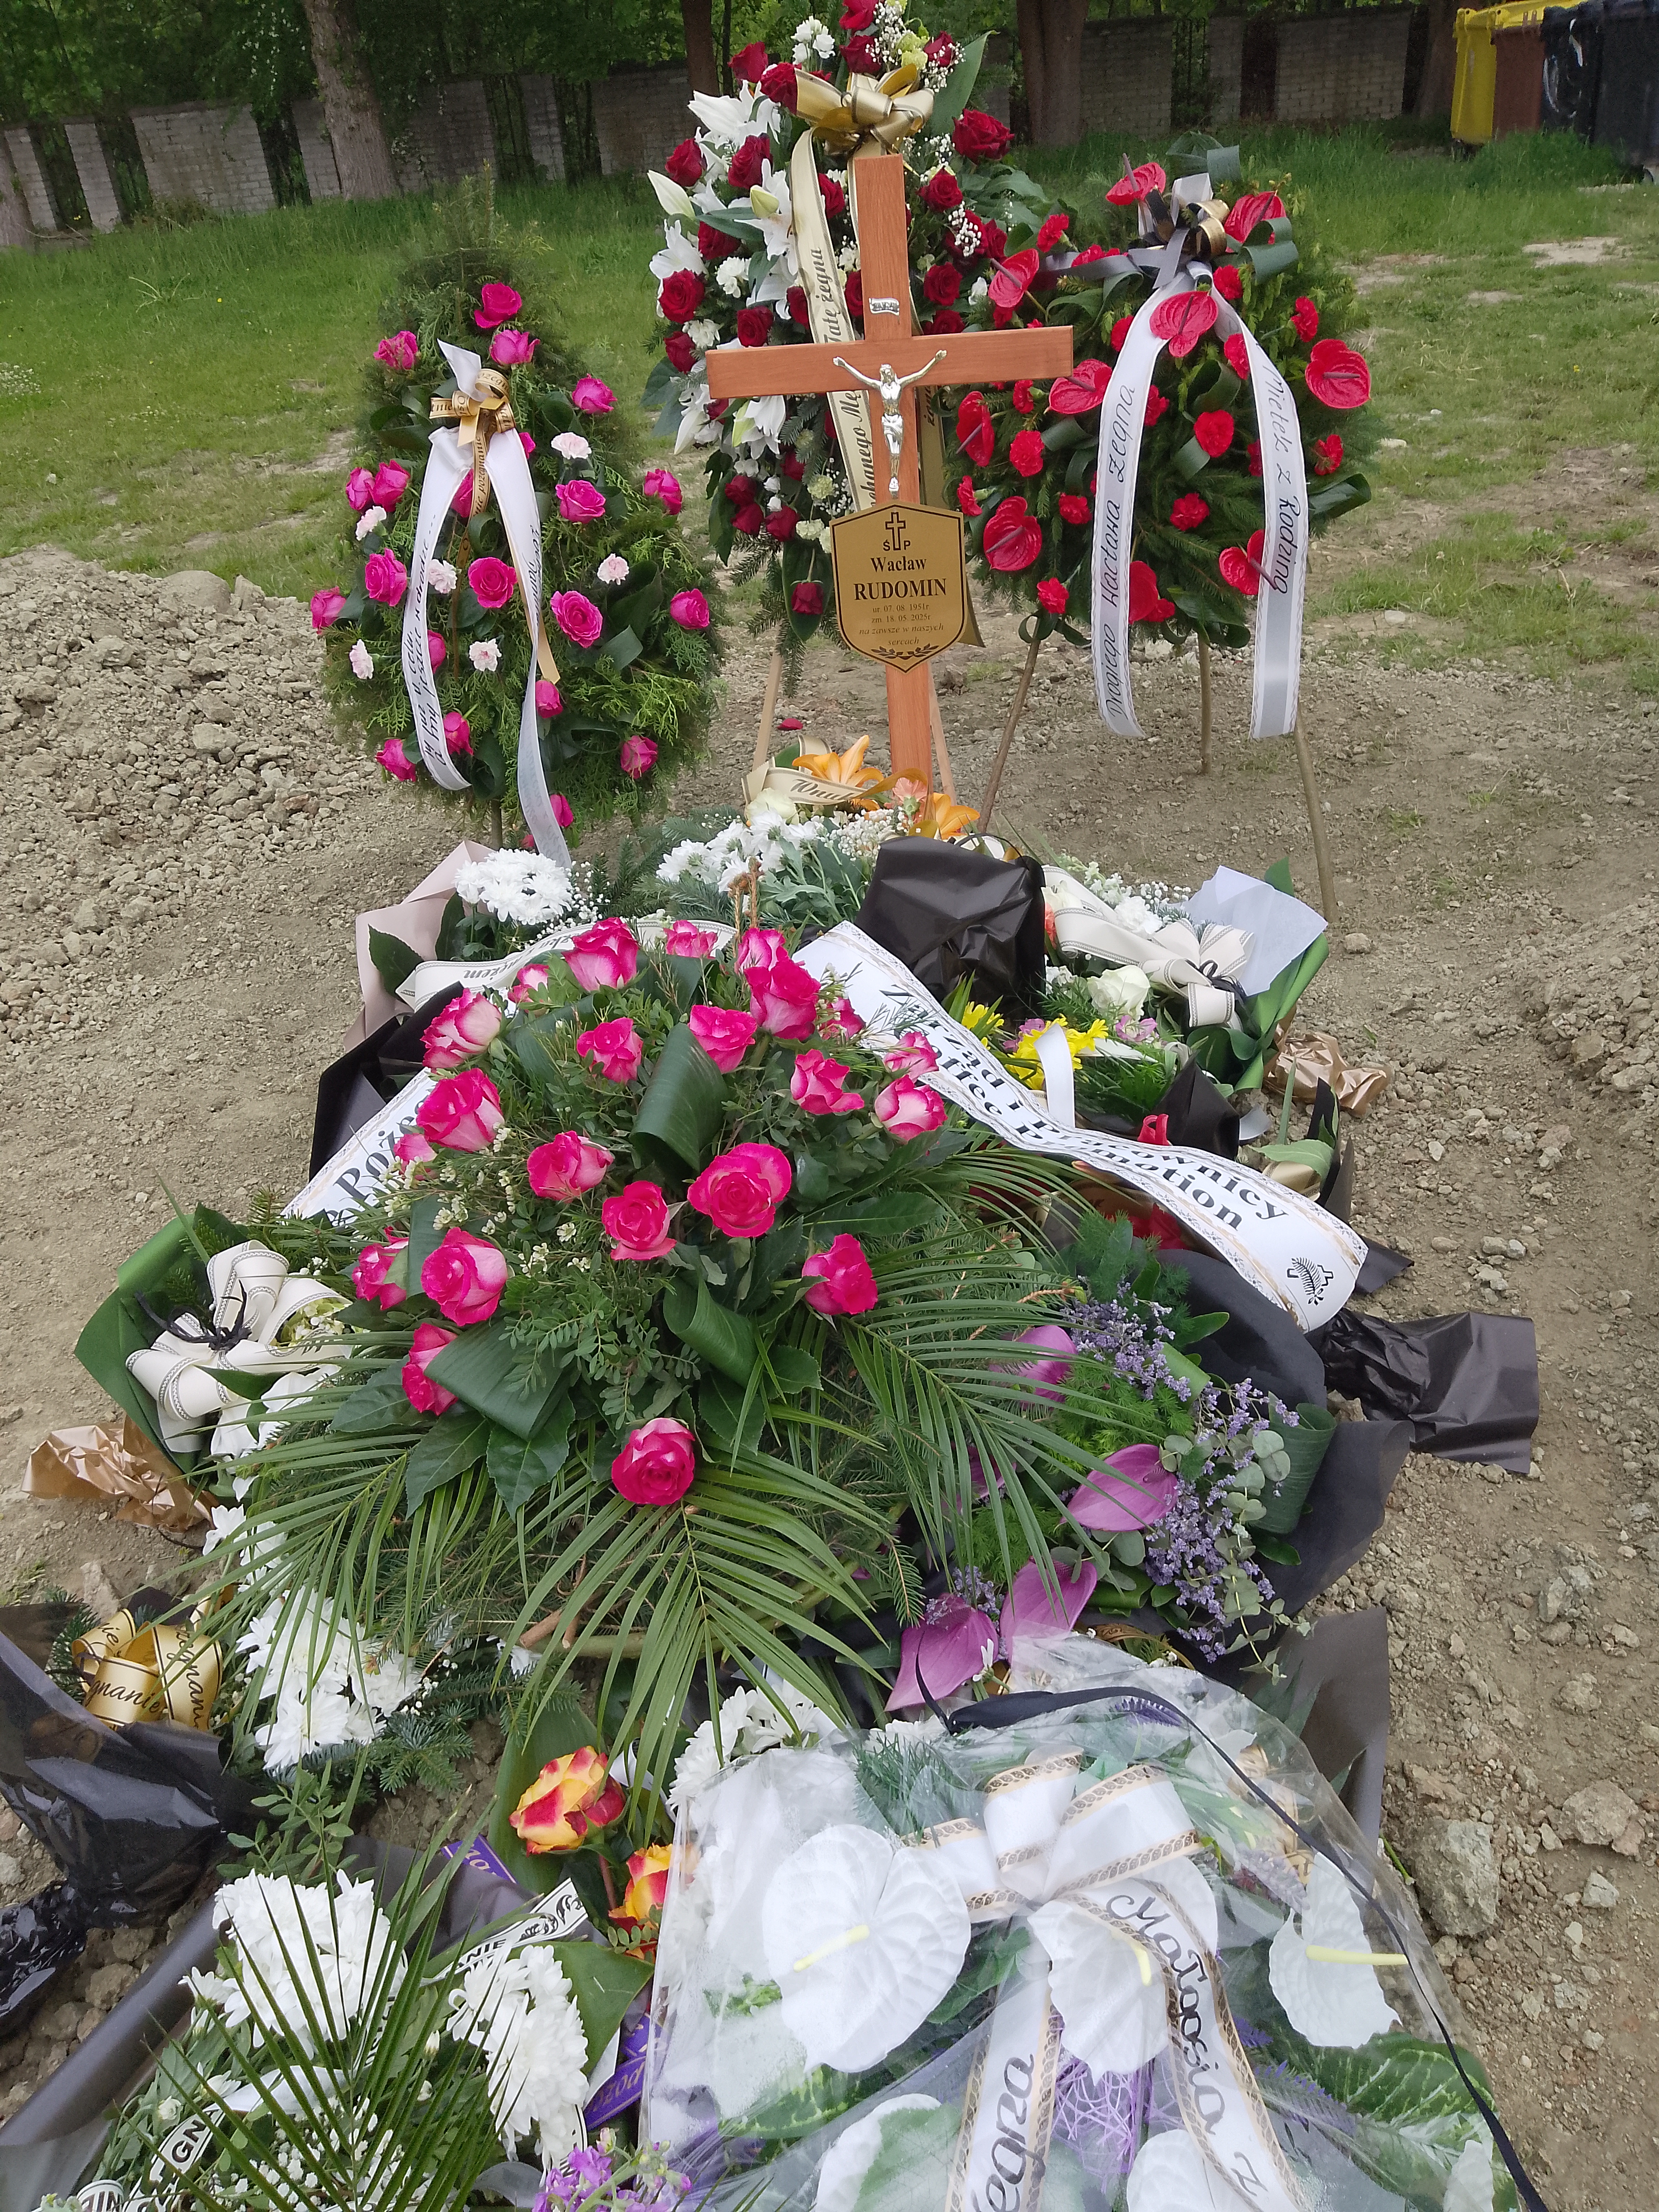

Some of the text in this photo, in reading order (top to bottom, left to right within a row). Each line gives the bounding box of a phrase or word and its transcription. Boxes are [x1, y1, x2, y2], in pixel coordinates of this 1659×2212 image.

[811, 247, 834, 302] żegna
[883, 539, 911, 552] Ś P
[870, 555, 927, 573] Wacław
[853, 578, 947, 601] RUDOMIN
[912, 623, 944, 633] naszych
[888, 636, 919, 646] sercach
[1101, 623, 1129, 720] Drogiego
[1005, 1100, 1026, 1112] i
[1030, 1119, 1289, 1220] Pracownicy
